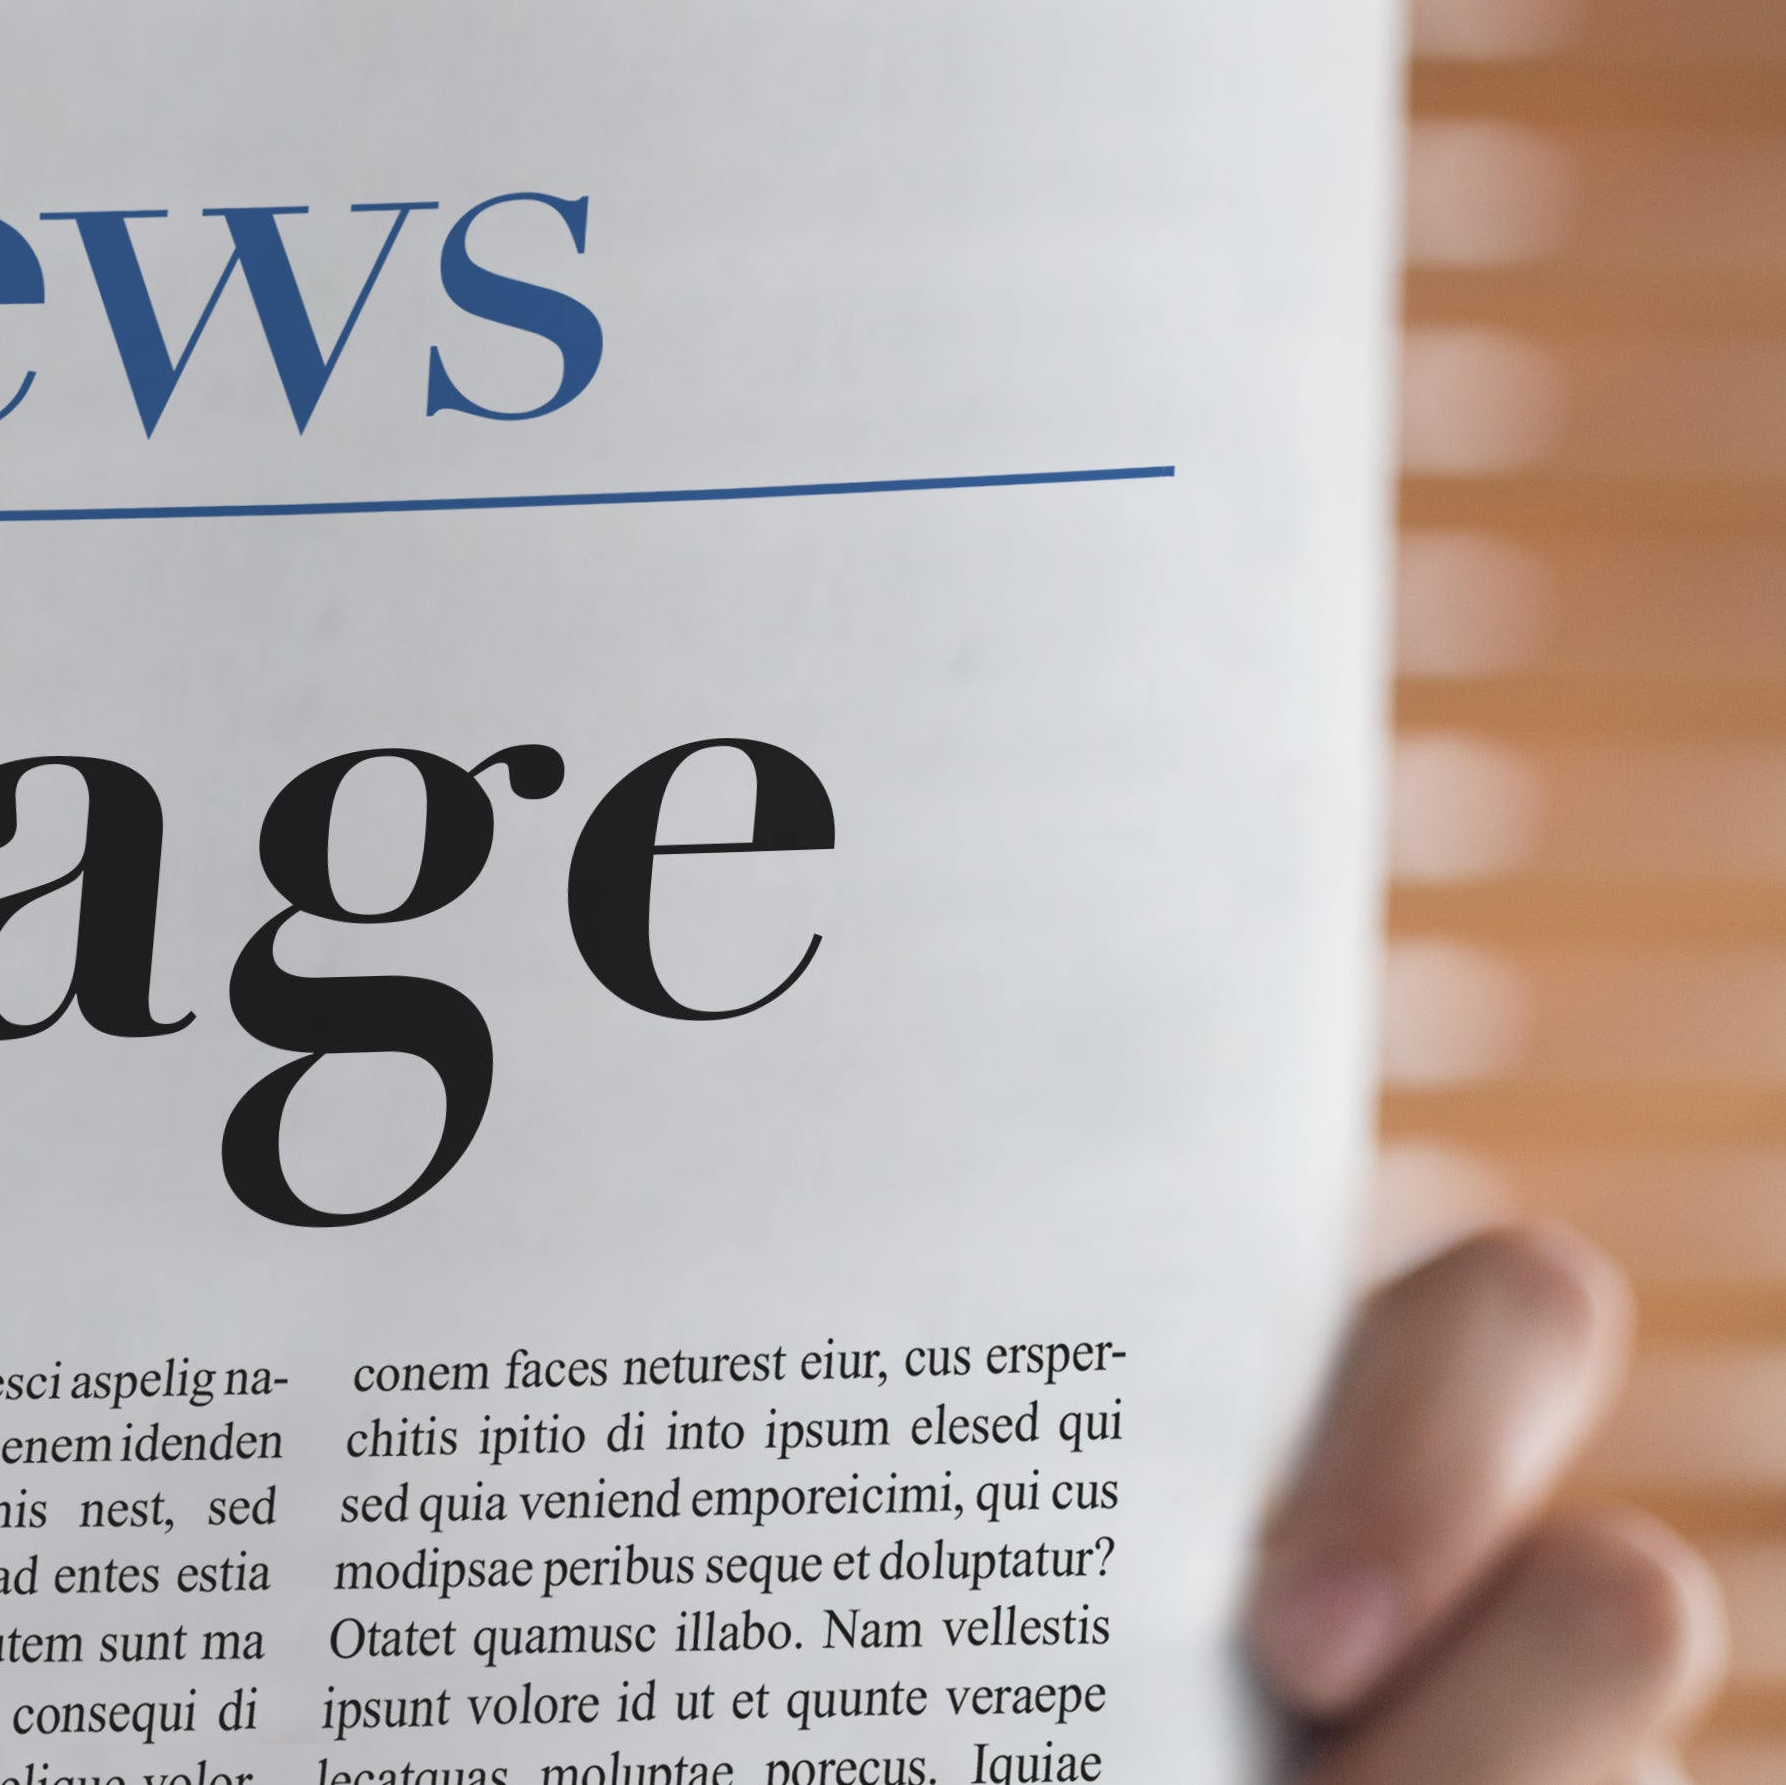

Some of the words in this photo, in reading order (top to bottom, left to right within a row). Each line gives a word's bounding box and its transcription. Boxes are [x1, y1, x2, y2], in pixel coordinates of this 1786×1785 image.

[71, 1358, 216, 1409] aspelig
[224, 1369, 288, 1395] na-
[354, 1363, 489, 1392] conem
[505, 1349, 607, 1389] faces
[623, 1346, 786, 1385] neturest
[801, 1338, 887, 1387] eiur,
[905, 1346, 970, 1376] cus
[987, 1342, 1126, 1385] ersper-
[121, 1421, 282, 1462] idenden
[347, 1416, 457, 1457] chitis
[479, 1414, 585, 1465] ipitio
[607, 1411, 644, 1452] di
[666, 1410, 744, 1450] into
[765, 1408, 889, 1459] ipsum
[912, 1400, 1039, 1445] elesed
[1059, 1398, 1122, 1452] qui
[80, 1492, 173, 1534] nest,
[209, 1485, 276, 1525] sed
[341, 1482, 408, 1523] sed
[420, 1481, 507, 1533] quia
[520, 1477, 680, 1520] veniend
[692, 1471, 963, 1526] emporeicimi,
[977, 1469, 1039, 1522] qui
[1052, 1481, 1118, 1510] cus
[55, 1559, 159, 1593] entes
[178, 1551, 270, 1592] estia
[334, 1547, 533, 1599] modipsae
[541, 1544, 694, 1598] peribus
[706, 1554, 822, 1594] seque
[834, 1546, 870, 1580] et
[880, 1536, 1114, 1590] doluptatur?
[100, 1625, 187, 1662] sunt
[201, 1631, 265, 1660] ma
[330, 1618, 456, 1659] Otatet
[474, 1624, 655, 1667] quamusc
[676, 1609, 802, 1651] illabo.
[823, 1609, 922, 1648] Nam
[942, 1604, 1109, 1646] vellestis
[13, 1689, 196, 1744] consequi
[219, 1687, 257, 1731] di
[322, 1686, 451, 1741] ipsunt
[468, 1682, 599, 1724] volore
[617, 1679, 655, 1722] id
[676, 1685, 715, 1720] ut
[733, 1684, 769, 1719] et
[787, 1681, 927, 1730] quunte
[946, 1684, 1105, 1724] veraepe
[971, 1741, 1101, 1785] Iquiae
